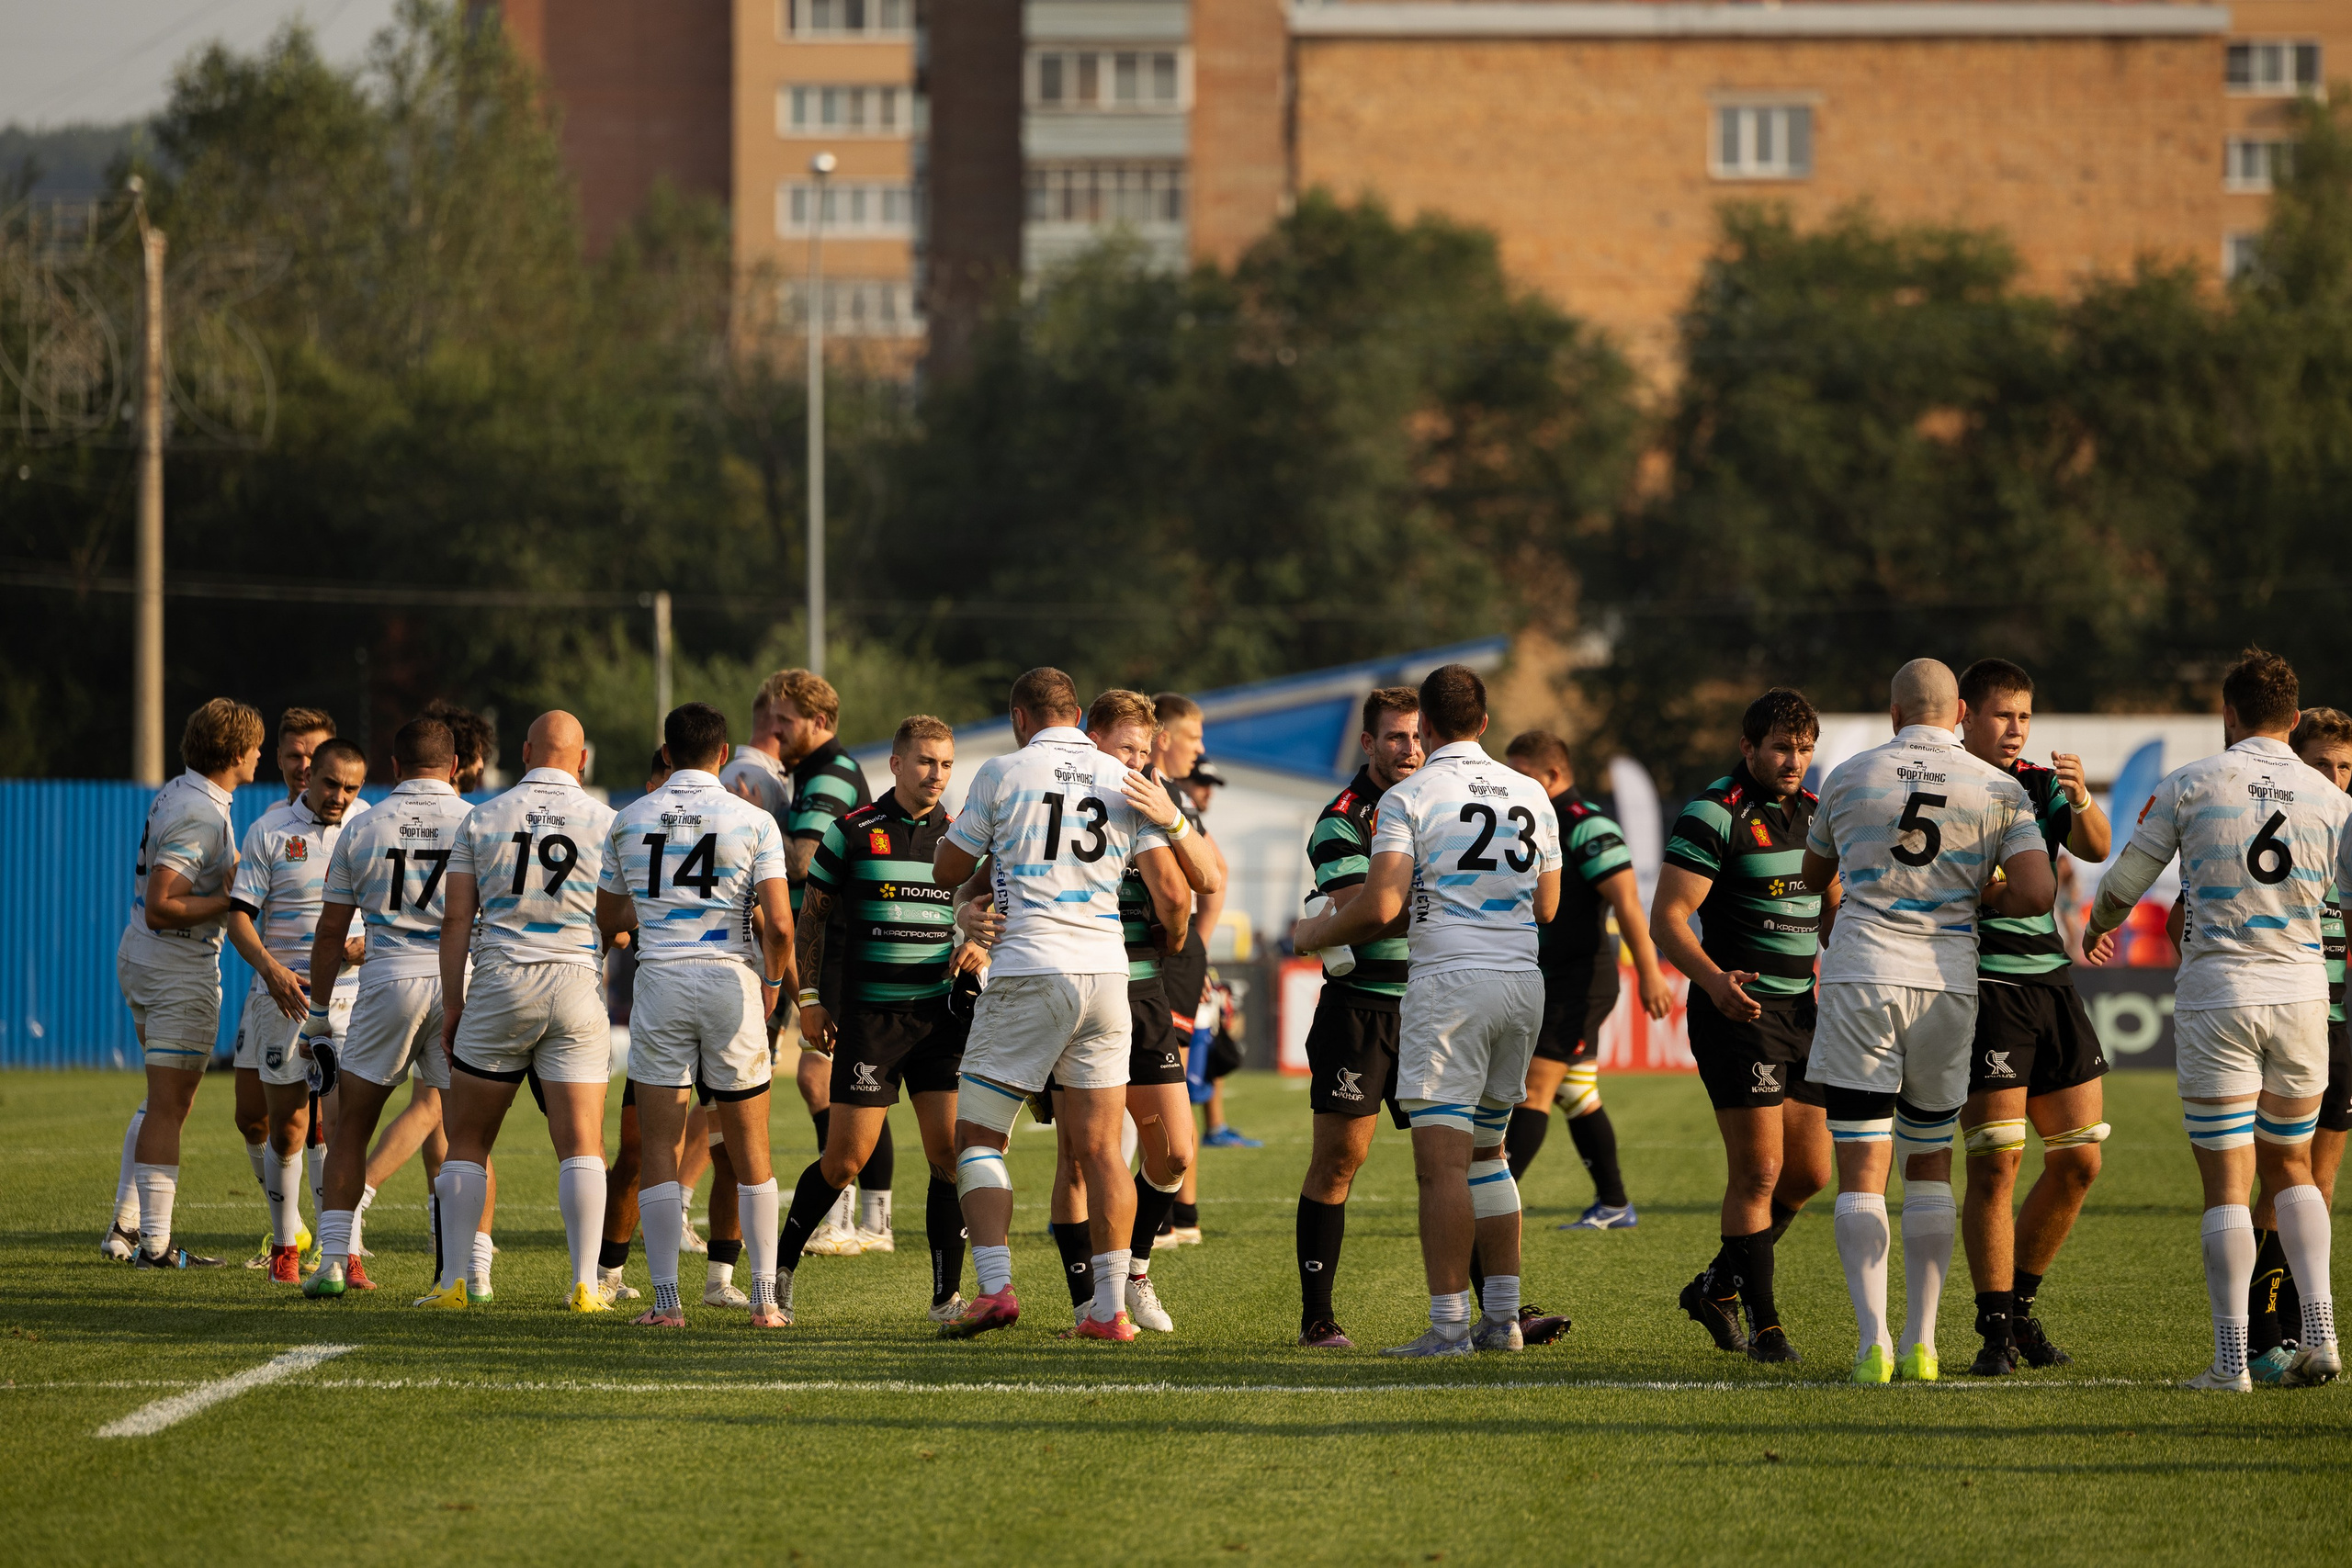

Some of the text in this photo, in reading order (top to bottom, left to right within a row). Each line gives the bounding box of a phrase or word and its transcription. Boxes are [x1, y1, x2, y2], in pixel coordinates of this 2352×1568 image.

[1909, 743, 1946, 754] centurion
[2253, 758, 2289, 767] centurion
[858, 814, 887, 828] centurion
[1042, 792, 1108, 863] 13
[1457, 802, 1537, 874] 23
[1889, 792, 1948, 867] 5
[2246, 809, 2293, 885] 6
[385, 848, 452, 911] 17
[512, 831, 578, 897] 19
[642, 832, 719, 898] 14
[901, 886, 951, 900] ПОЛЮС
[1416, 895, 1430, 923] СТМ
[2183, 909, 2193, 942] СТМ
